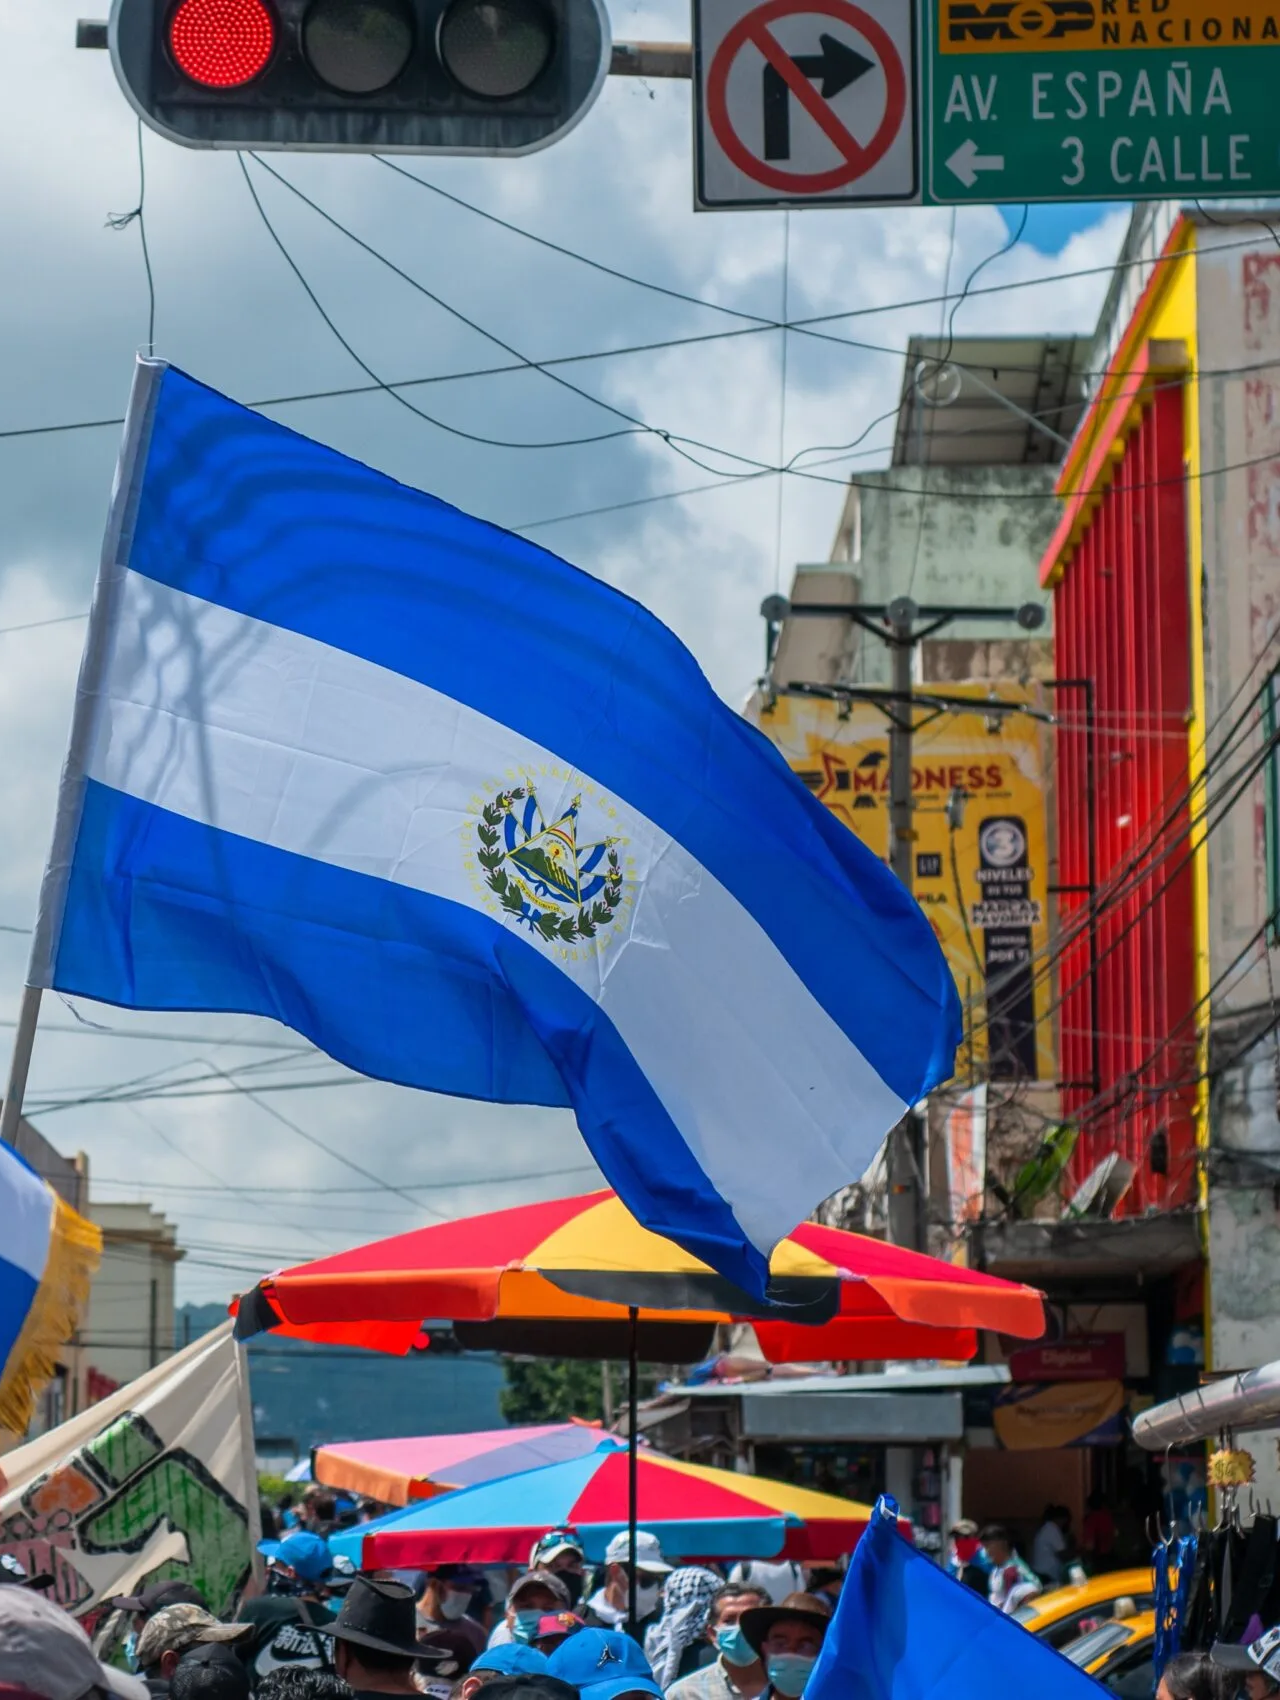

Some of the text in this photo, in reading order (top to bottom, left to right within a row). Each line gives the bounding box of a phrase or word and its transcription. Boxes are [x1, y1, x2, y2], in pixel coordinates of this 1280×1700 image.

[1102, 0, 1170, 14] RED
[948, 1, 1095, 41] MOP
[1102, 17, 1280, 44] NACIONA
[944, 61, 1232, 123] AV. ESPAÑA
[1061, 134, 1252, 185] 3 CALLE
[993, 830, 1015, 858] 3
[976, 868, 1033, 882] NIVELES
[1041, 1348, 1093, 1367] Digicel
